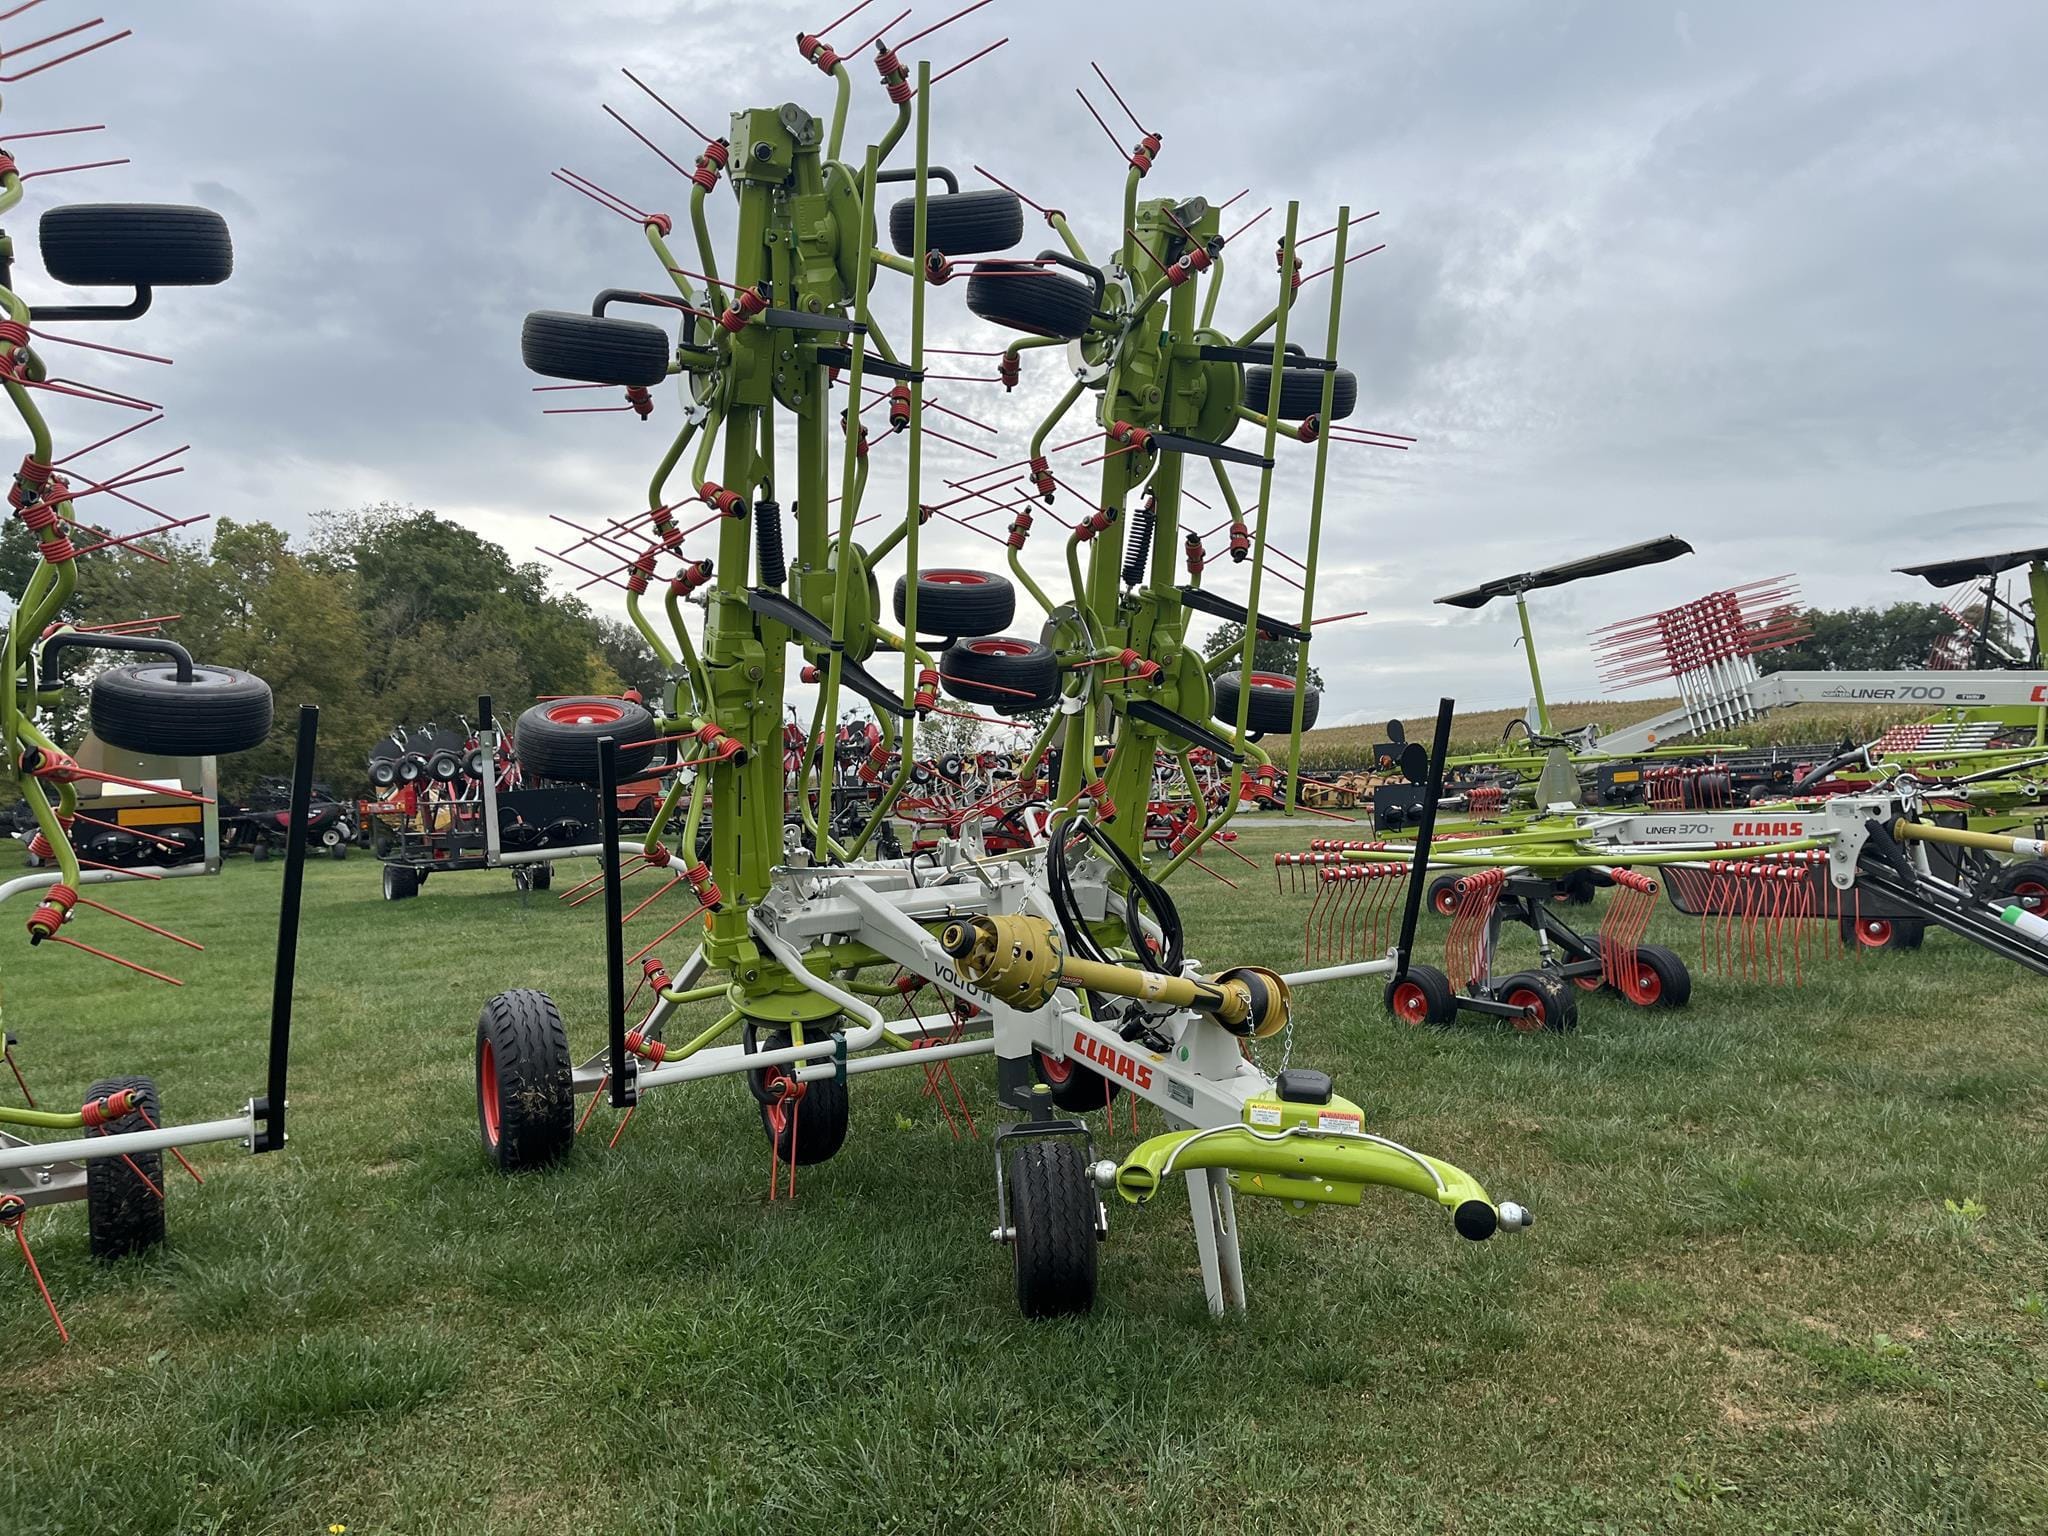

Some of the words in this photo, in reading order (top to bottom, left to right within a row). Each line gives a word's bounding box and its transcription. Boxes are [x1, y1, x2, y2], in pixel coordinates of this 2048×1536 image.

[1851, 688, 1896, 699] LINER
[1898, 686, 1945, 700] 700
[1645, 825, 1676, 835] LINER
[1732, 822, 1803, 836] CLAAS
[1073, 1031, 1153, 1090] CLAAS
[1327, 1111, 1360, 1121] WARNING
